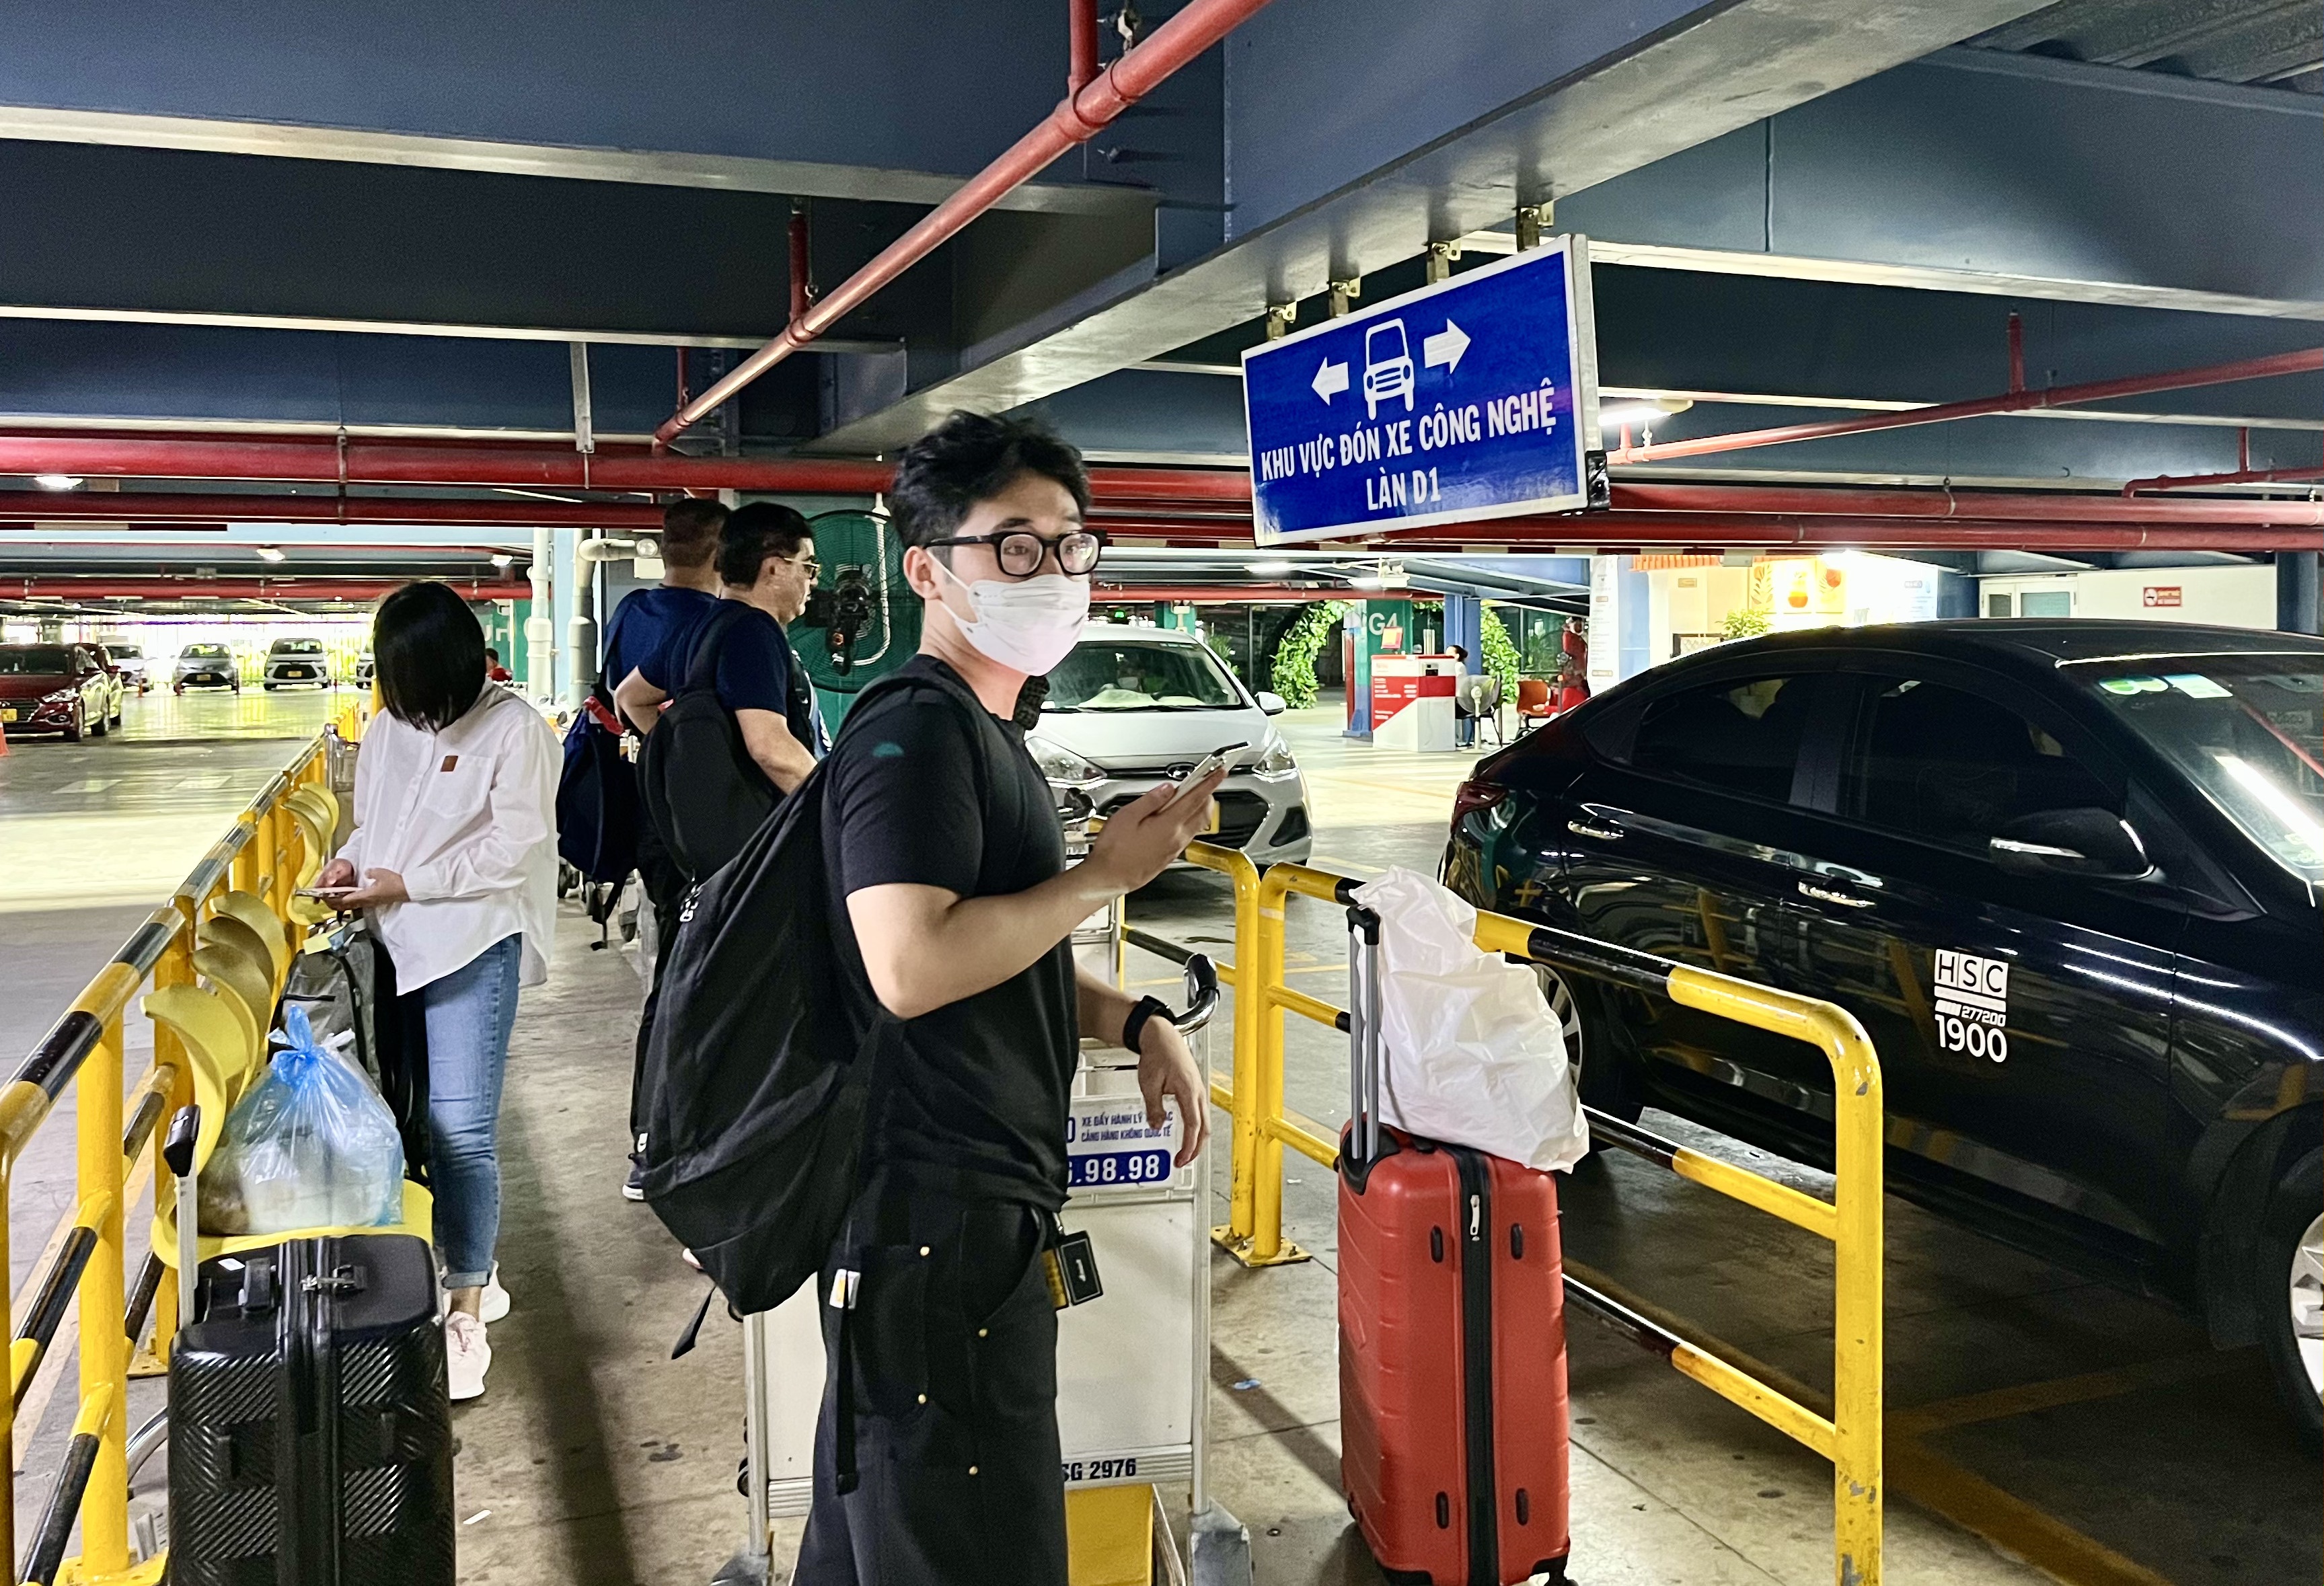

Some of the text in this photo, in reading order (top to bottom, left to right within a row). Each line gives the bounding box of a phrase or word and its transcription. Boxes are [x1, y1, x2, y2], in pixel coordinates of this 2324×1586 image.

[1261, 377, 1557, 481] KHU VỰC ĐÓN XE CÔNG NGHỆ
[1367, 467, 1442, 511] LÀN D1
[1938, 953, 2004, 993] HSC
[1961, 1005, 2007, 1027] 277200
[1935, 1014, 2008, 1063] 1900
[1089, 1458, 1136, 1480] 2976
